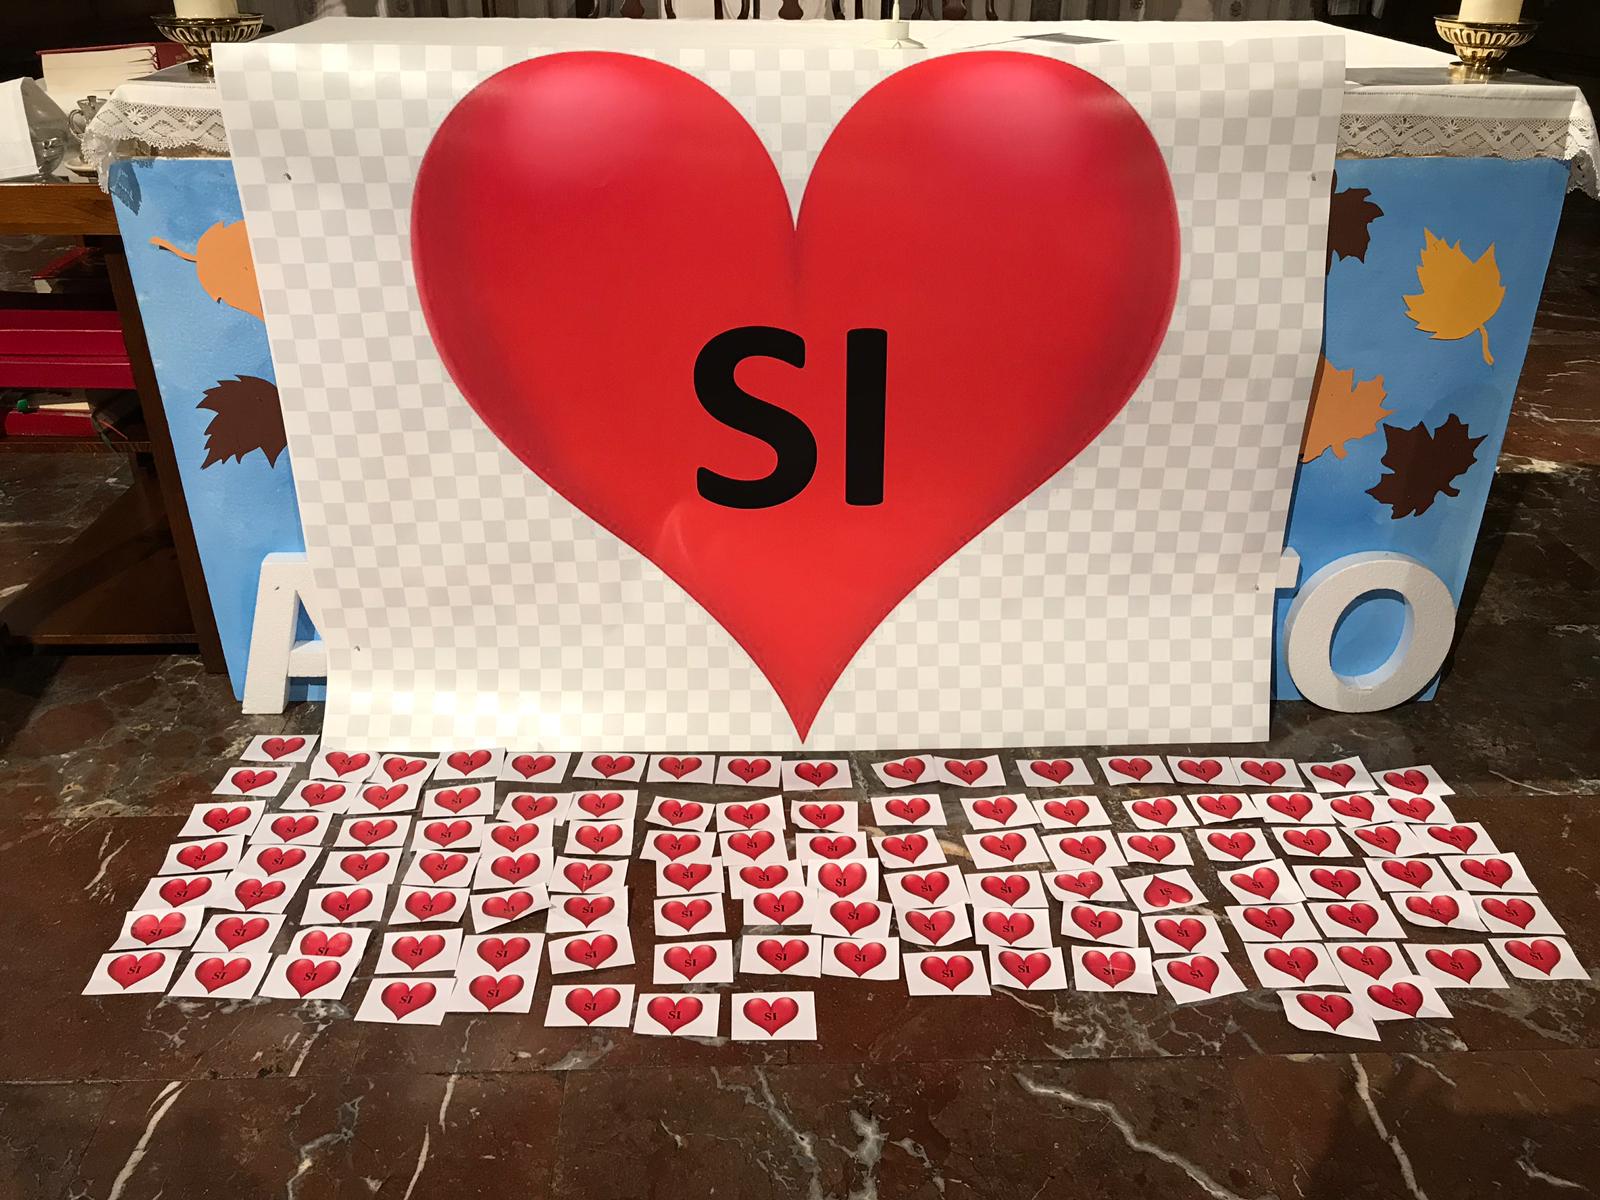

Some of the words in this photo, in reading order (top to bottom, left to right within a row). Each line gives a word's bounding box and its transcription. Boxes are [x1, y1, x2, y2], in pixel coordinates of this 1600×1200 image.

[693, 325, 888, 510] SI
[835, 878, 848, 887] SI
[338, 903, 351, 911] SI
[848, 912, 860, 920] SI
[1505, 908, 1519, 917] SI
[1089, 920, 1103, 928] SI
[1264, 919, 1278, 928] SI
[1348, 916, 1361, 924] SI
[233, 928, 246, 936] SI
[1177, 929, 1190, 937] SI
[411, 948, 423, 956] SI
[495, 950, 508, 958] SI
[585, 951, 597, 959] SI
[775, 953, 787, 961] SI
[854, 954, 866, 962] SI
[1530, 952, 1544, 961] SI
[684, 959, 696, 967] SI
[1287, 960, 1301, 969] SI
[1361, 957, 1375, 966] SI
[1450, 961, 1464, 969] SI
[127, 966, 141, 974] SI
[942, 969, 954, 977] SI
[1017, 965, 1031, 973] SI
[211, 971, 227, 980] SI
[303, 972, 318, 981] SI
[1190, 970, 1204, 979] SI
[486, 989, 500, 997] SI
[399, 995, 413, 1004] SI
[1391, 997, 1408, 1006] SI
[583, 1002, 597, 1011] SI
[1319, 1003, 1334, 1012] SI
[668, 1011, 681, 1019] SI
[764, 1012, 777, 1020] SI
